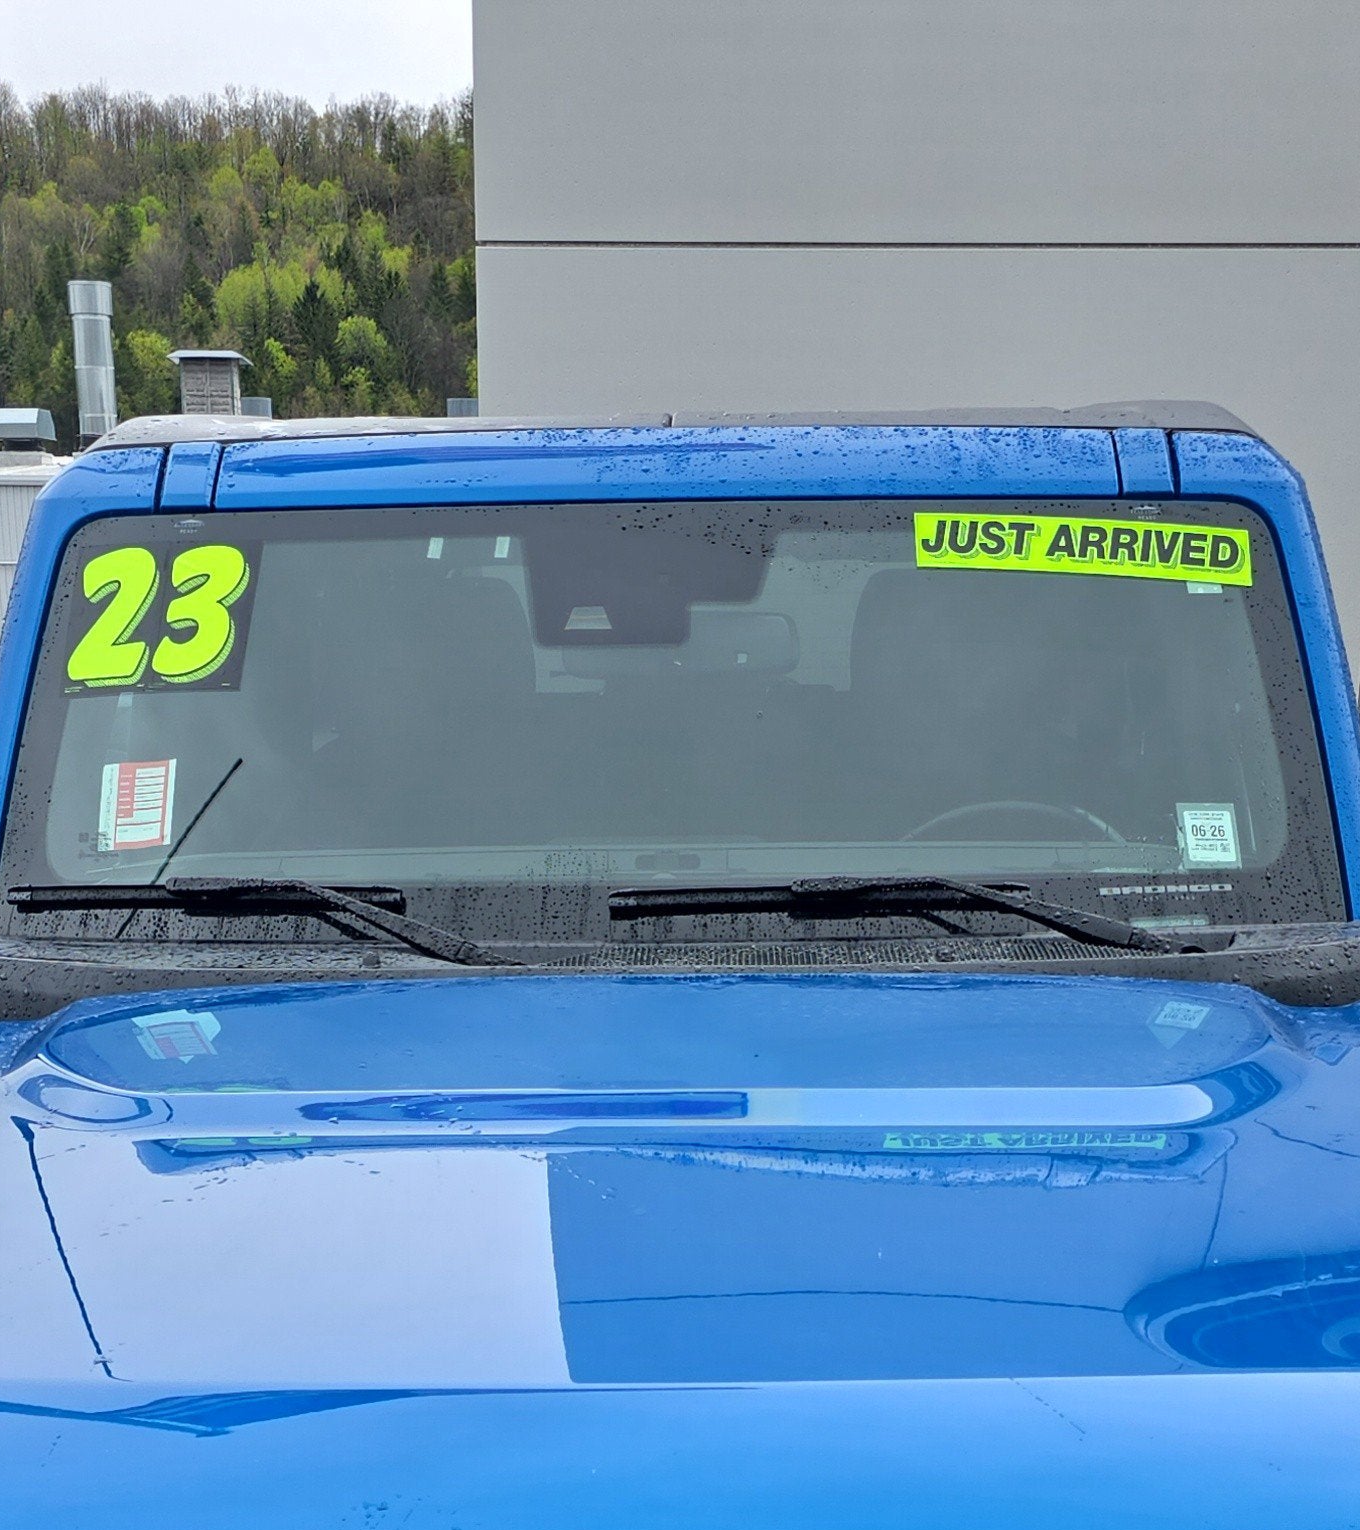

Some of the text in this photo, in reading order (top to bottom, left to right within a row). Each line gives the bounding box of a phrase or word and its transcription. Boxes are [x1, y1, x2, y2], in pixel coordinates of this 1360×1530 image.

[921, 520, 1244, 572] JUST ARRIVED
[67, 545, 250, 687] 23
